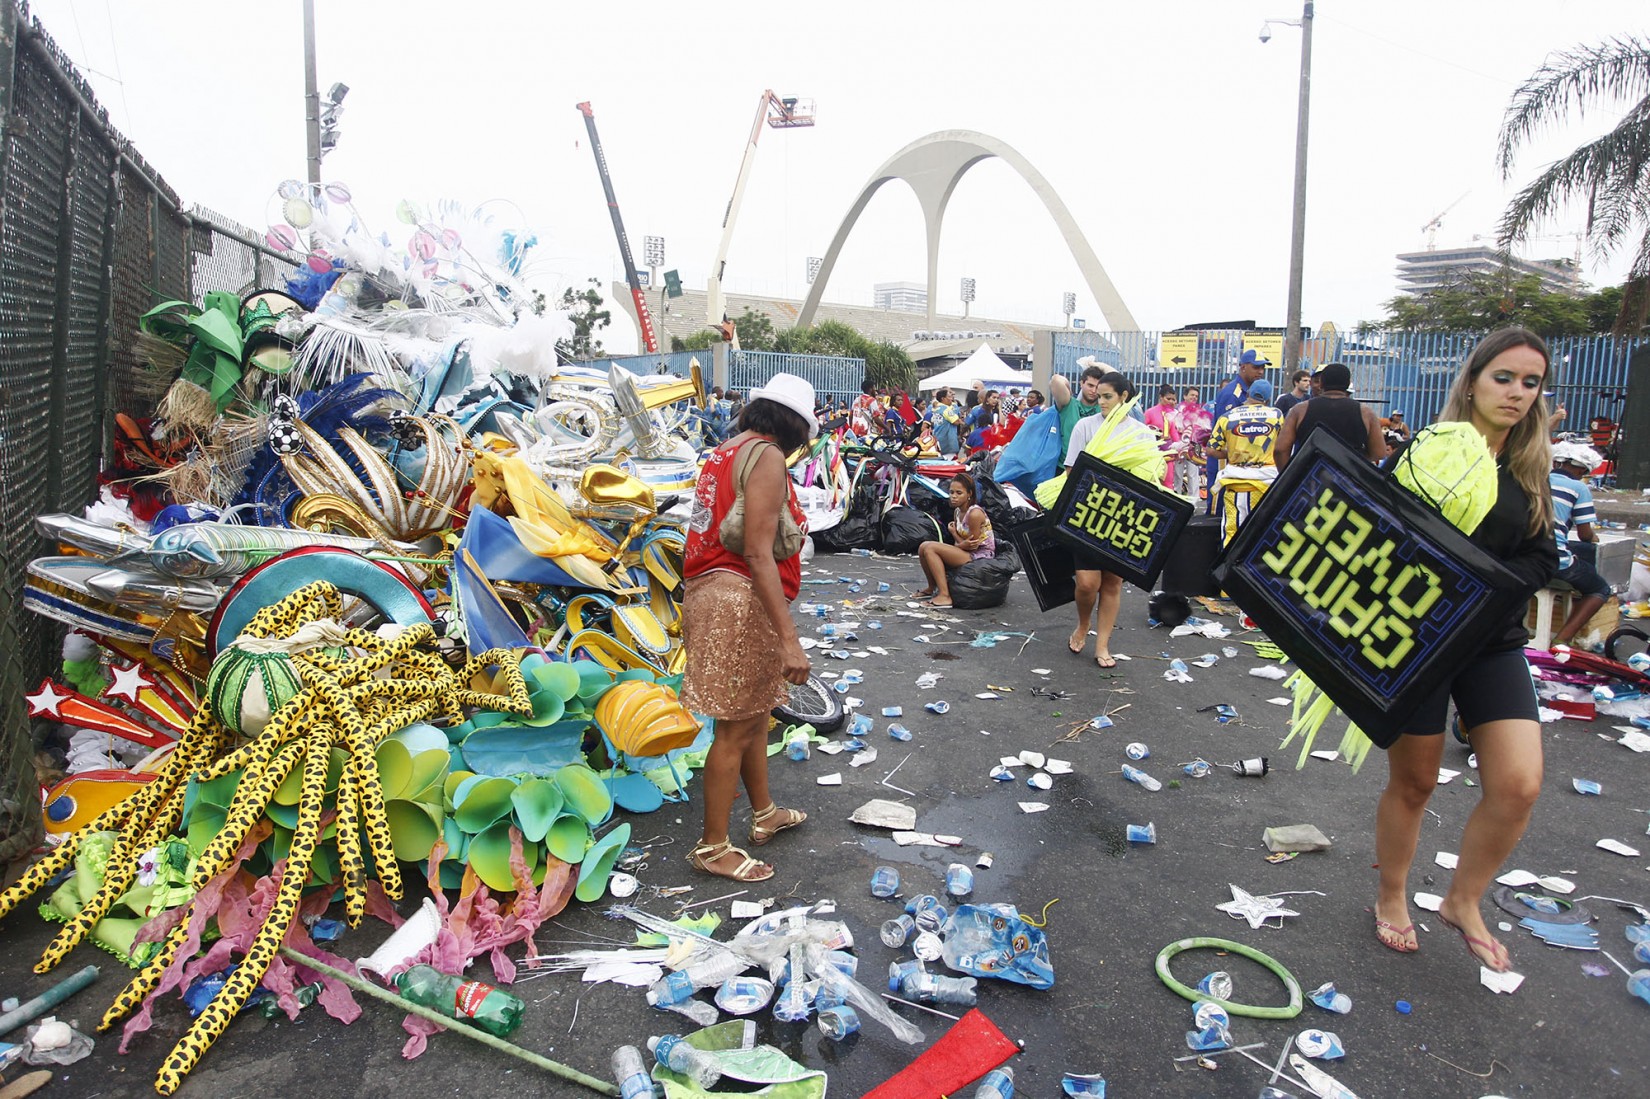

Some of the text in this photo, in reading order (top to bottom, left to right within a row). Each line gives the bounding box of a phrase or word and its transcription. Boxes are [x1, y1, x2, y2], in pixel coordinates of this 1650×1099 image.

[1239, 425, 1268, 434] Latrop
[1068, 501, 1153, 558] GAME
[1086, 482, 1159, 534] OVER
[1304, 487, 1443, 620] OVER
[1262, 521, 1415, 670] GAME
